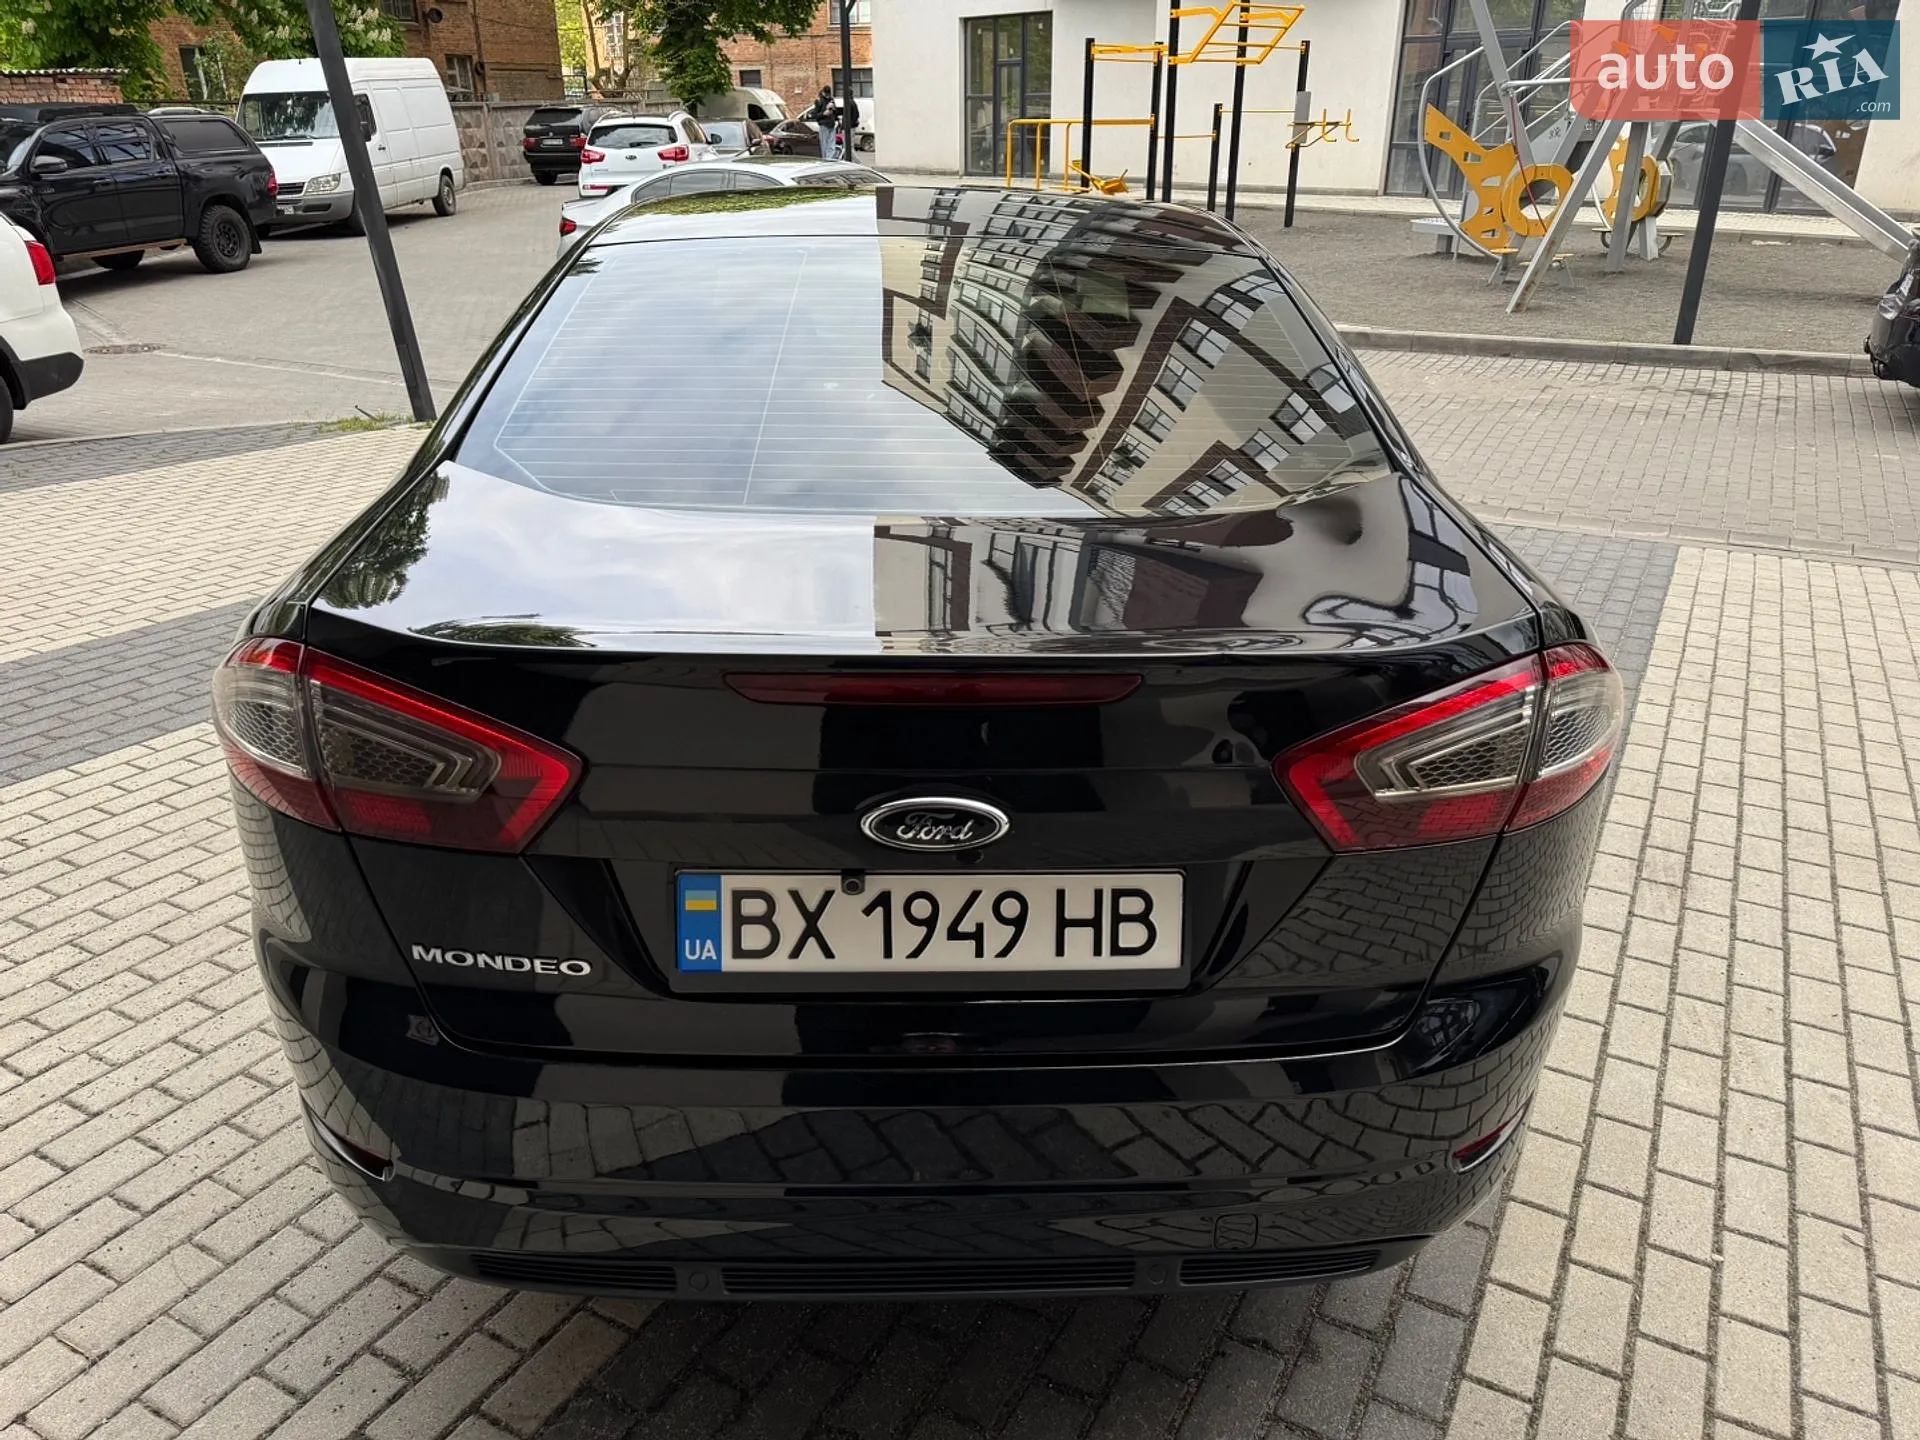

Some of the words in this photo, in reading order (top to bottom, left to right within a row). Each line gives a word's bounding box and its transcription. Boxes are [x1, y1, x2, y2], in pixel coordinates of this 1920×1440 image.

[896, 812, 974, 842] Ford
[731, 889, 836, 960] BX
[862, 889, 1029, 959] 1949
[1055, 887, 1157, 958] HB
[411, 944, 592, 976] MONDEO
[684, 939, 717, 961] UA
